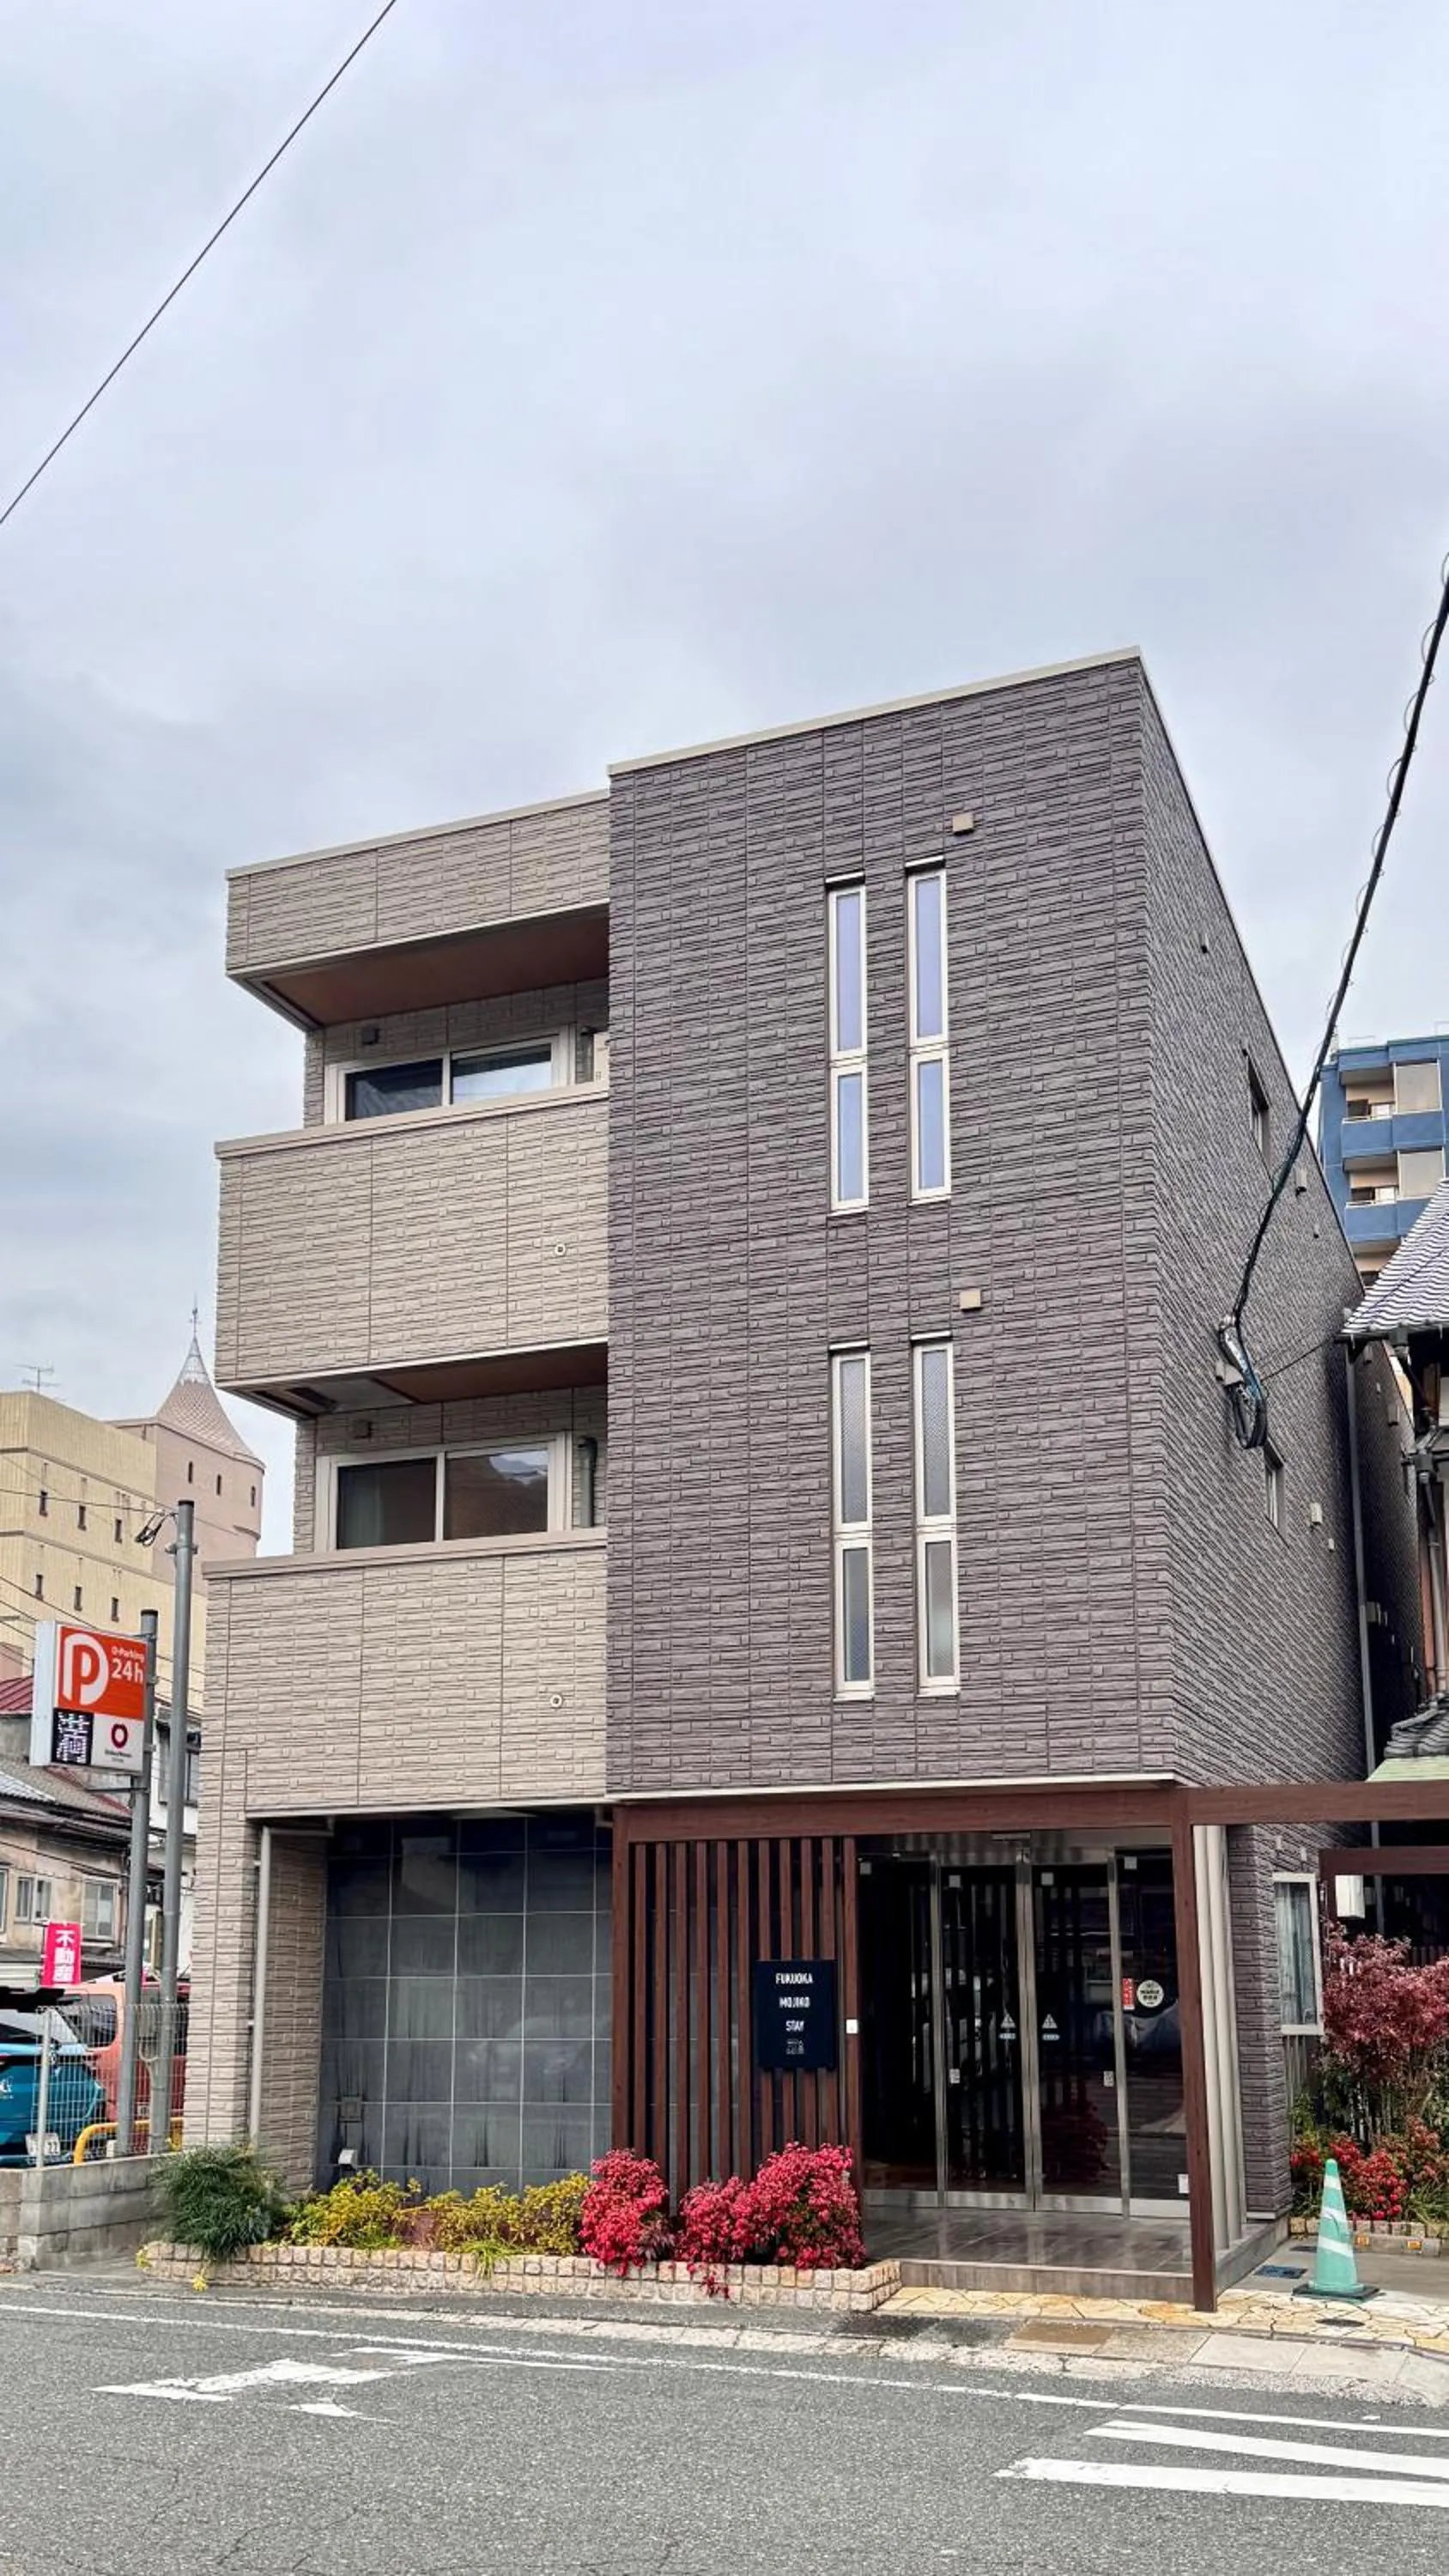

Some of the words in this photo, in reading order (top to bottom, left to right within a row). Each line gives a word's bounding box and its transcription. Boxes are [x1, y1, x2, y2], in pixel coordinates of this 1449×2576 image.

[63, 1632, 109, 1705] P
[112, 1658, 144, 1683] 24h
[775, 1973, 814, 1984] FUKUOKA
[779, 1996, 810, 2008] MOJIKO
[785, 2020, 805, 2032] STAY
